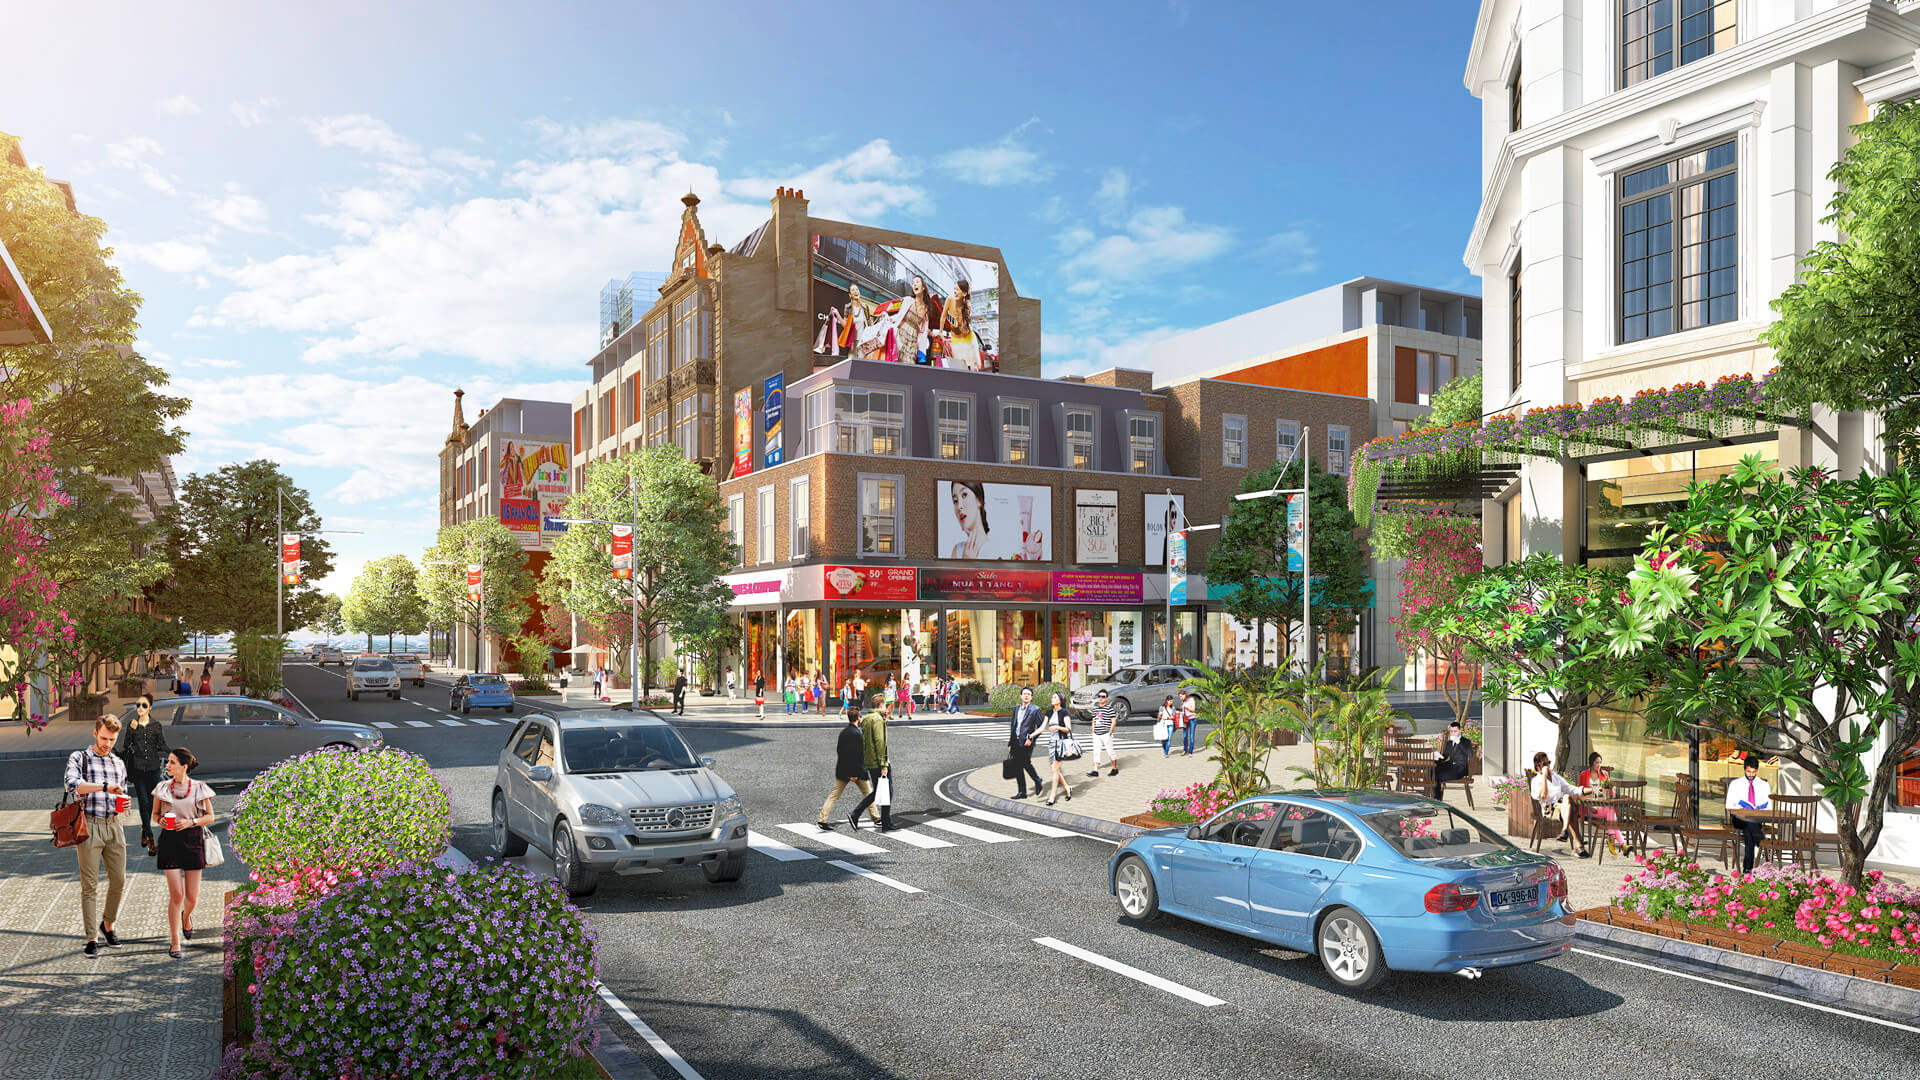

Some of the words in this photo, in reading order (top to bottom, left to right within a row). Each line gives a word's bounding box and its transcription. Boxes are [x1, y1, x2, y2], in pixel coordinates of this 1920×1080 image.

[1090, 516, 1105, 527] BIG
[1087, 526, 1107, 536] SALE
[887, 568, 914, 576] GRAND
[976, 571, 998, 579] Sale
